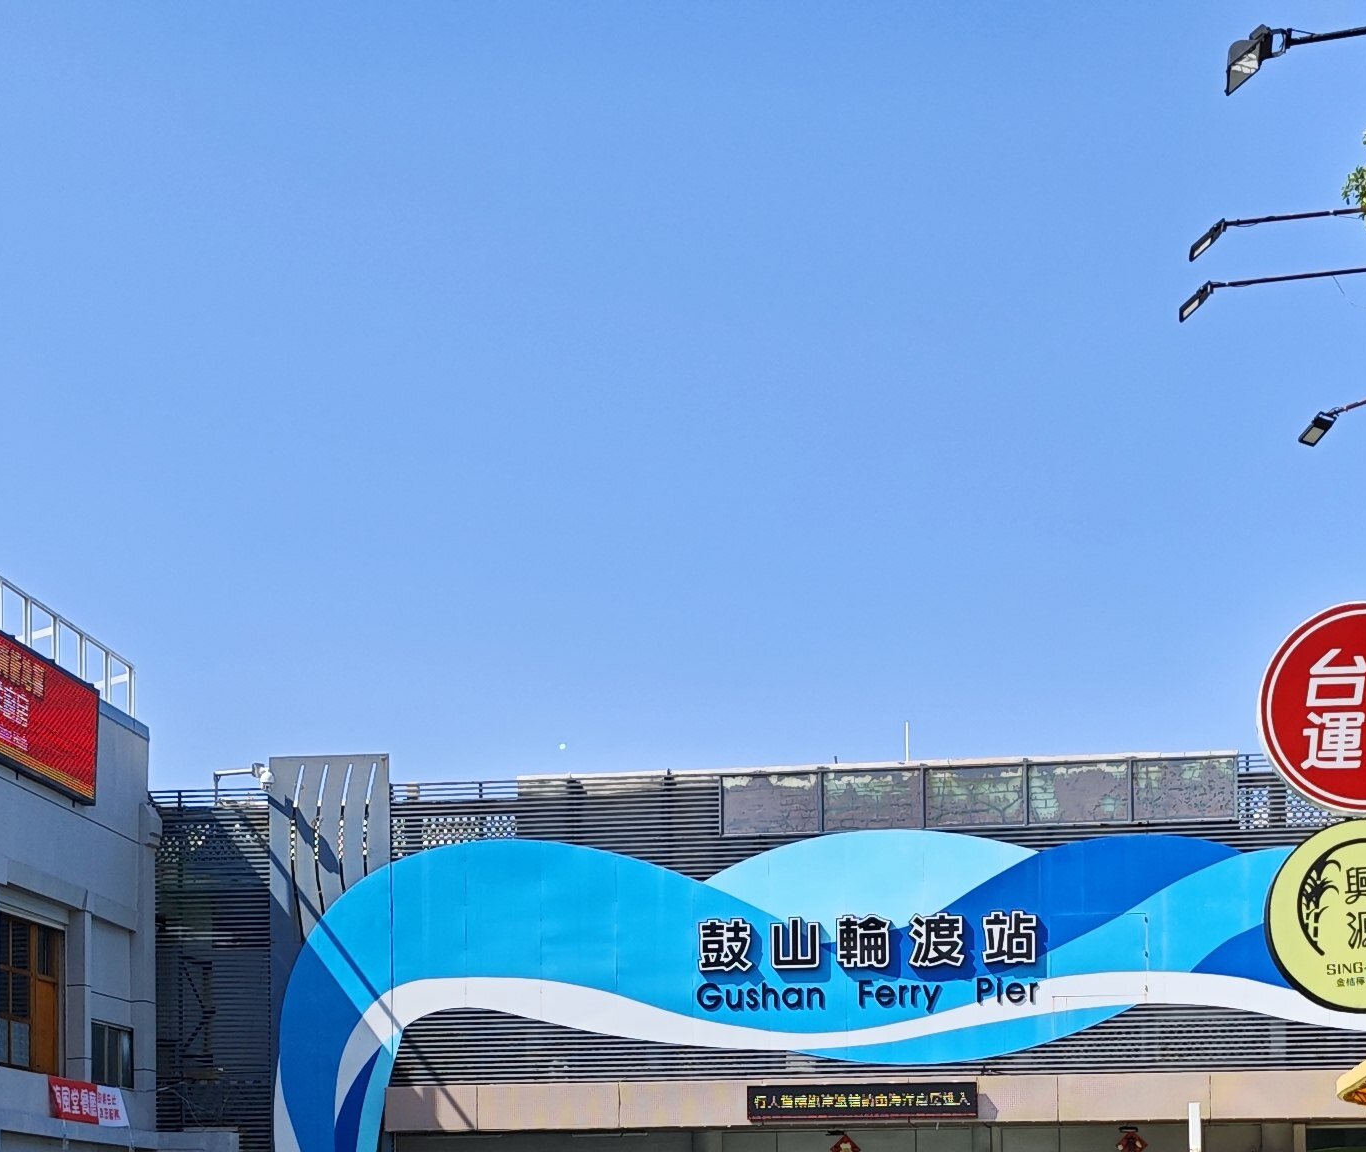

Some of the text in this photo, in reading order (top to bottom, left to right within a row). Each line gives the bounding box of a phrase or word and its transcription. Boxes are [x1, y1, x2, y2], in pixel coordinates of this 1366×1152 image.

[699, 911, 1037, 972] 鼓山輪渡站
[696, 977, 1040, 1014] Gushan Ferry Pier
